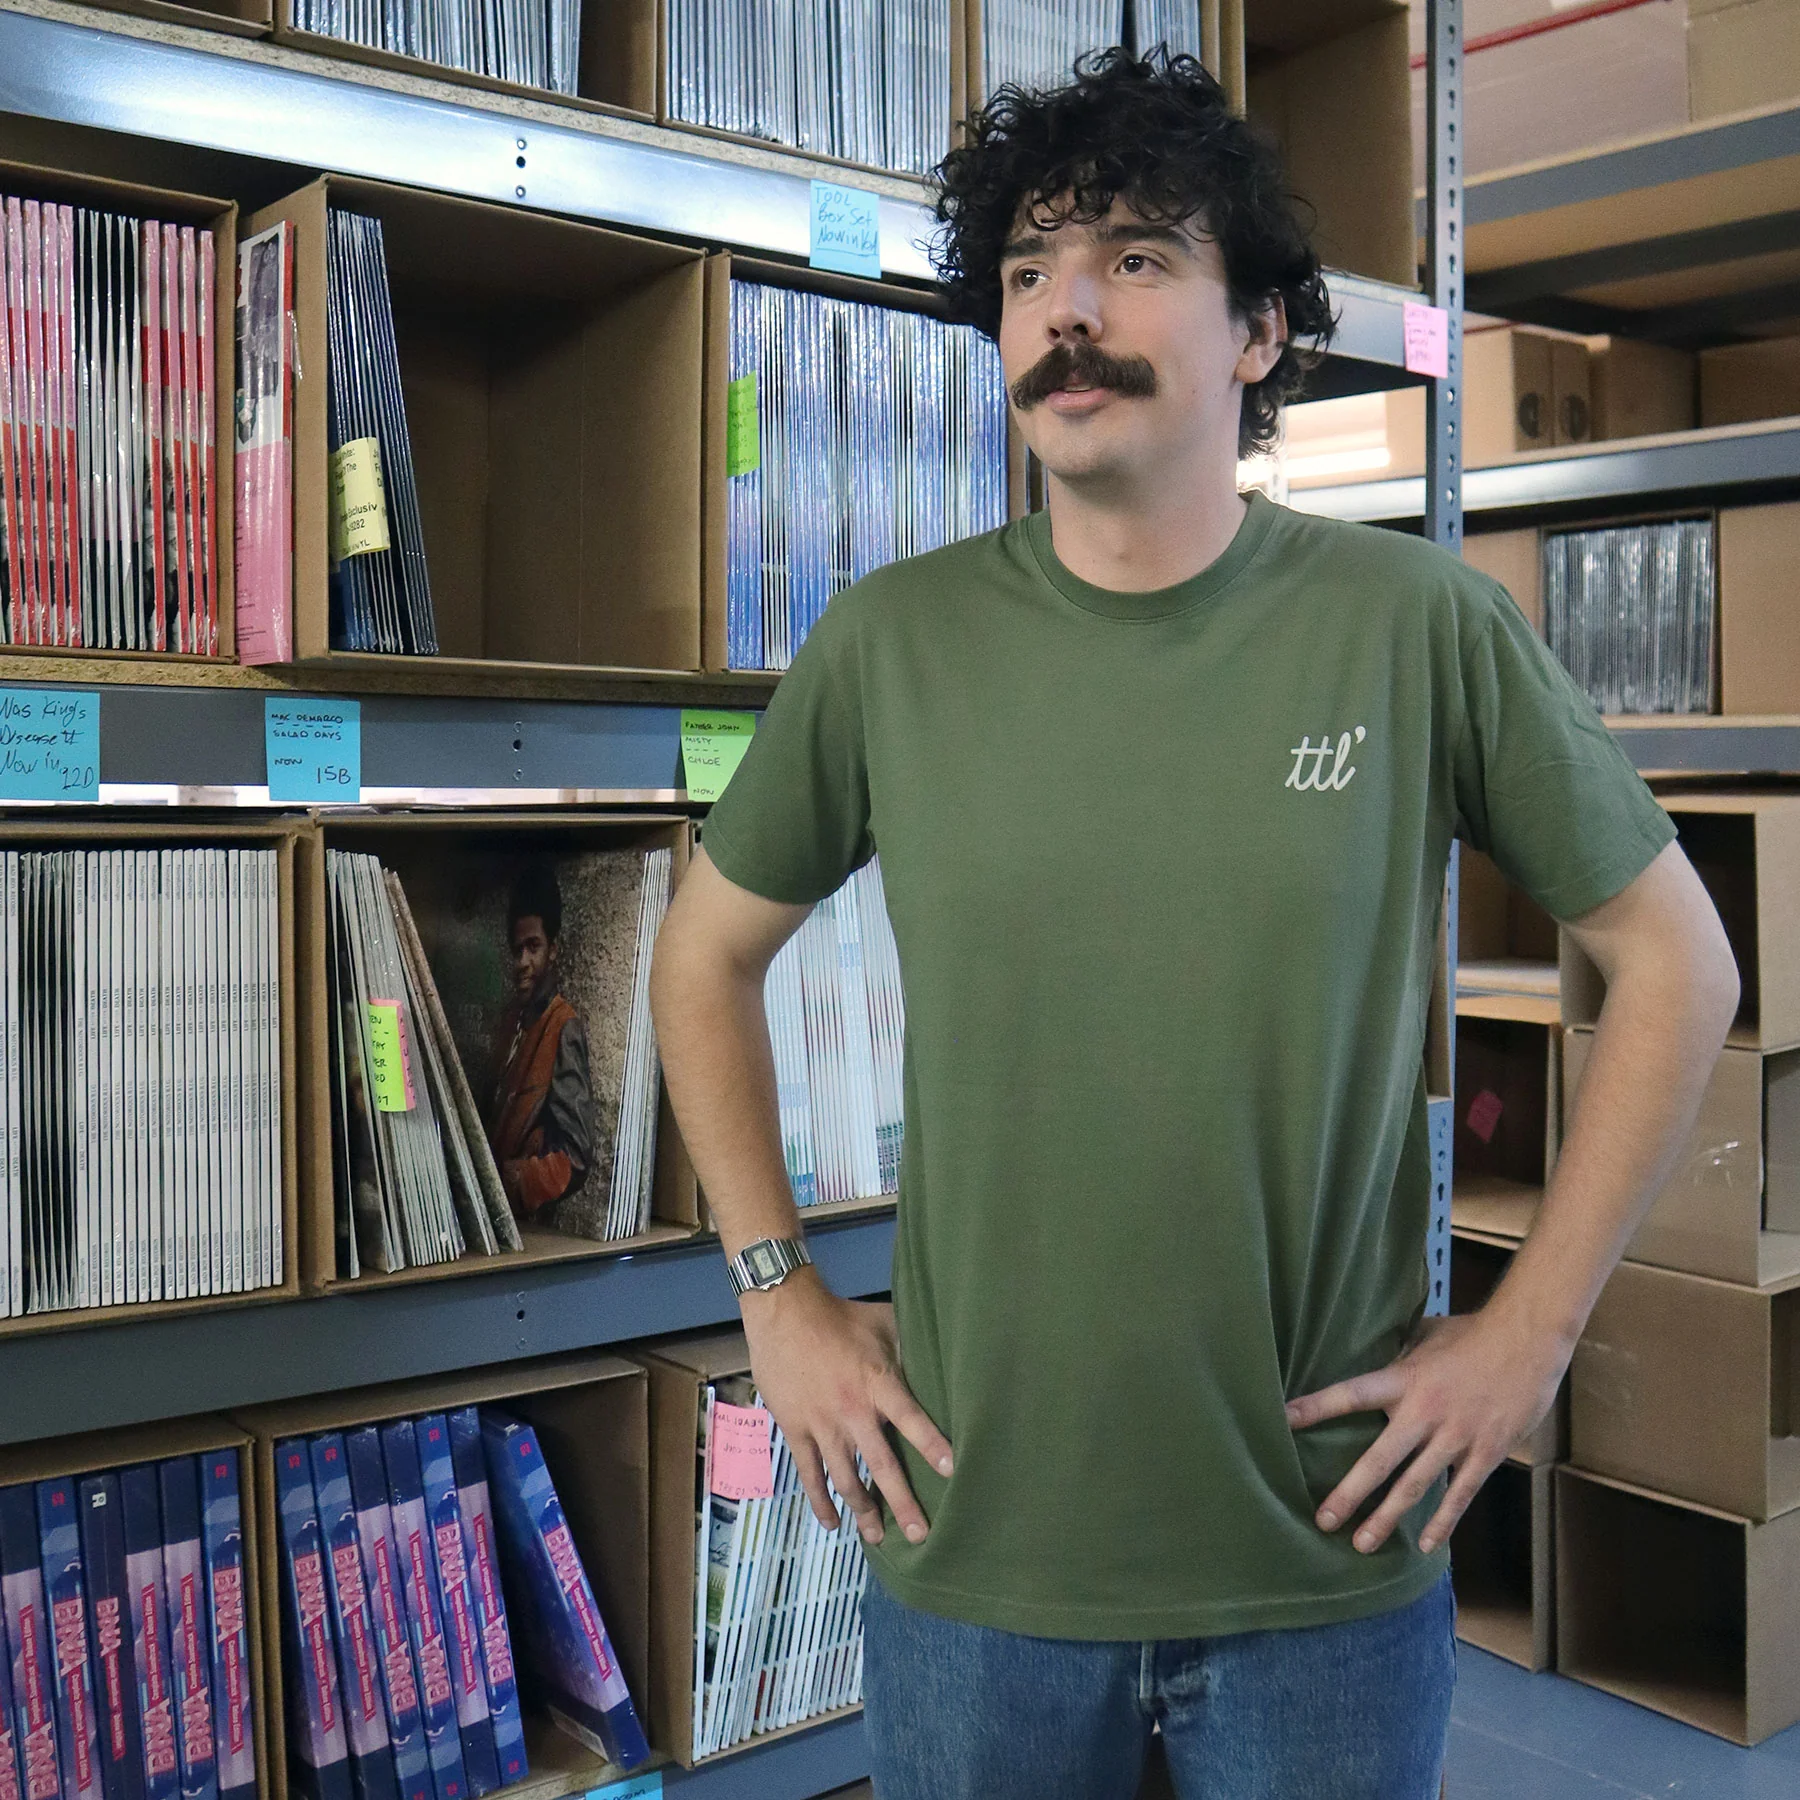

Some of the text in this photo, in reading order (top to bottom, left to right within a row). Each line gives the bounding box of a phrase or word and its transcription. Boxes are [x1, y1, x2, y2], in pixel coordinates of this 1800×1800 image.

[815, 187, 851, 206] TOOL
[818, 203, 845, 222] Box
[0, 696, 31, 719] Nas
[271, 713, 344, 724] MAC DEMARCO
[273, 729, 342, 740] SALAD DAYS
[0, 749, 38, 775] Now
[274, 758, 302, 766] NOW
[317, 765, 351, 785] 15B
[294, 1553, 327, 1626] BNA
[333, 1544, 366, 1617] BNA
[435, 1522, 466, 1593] BNA
[544, 1525, 582, 1593] BNA
[54, 1598, 88, 1676] BNA
[96, 1597, 121, 1657] BNA
[214, 1567, 243, 1642] BNA
[385, 1641, 417, 1716] BNA
[419, 1633, 450, 1707] BNA
[482, 1614, 512, 1685] BNA
[24, 1721, 58, 1800] BNA
[143, 1698, 175, 1776] BNA
[181, 1687, 213, 1763] BNA
